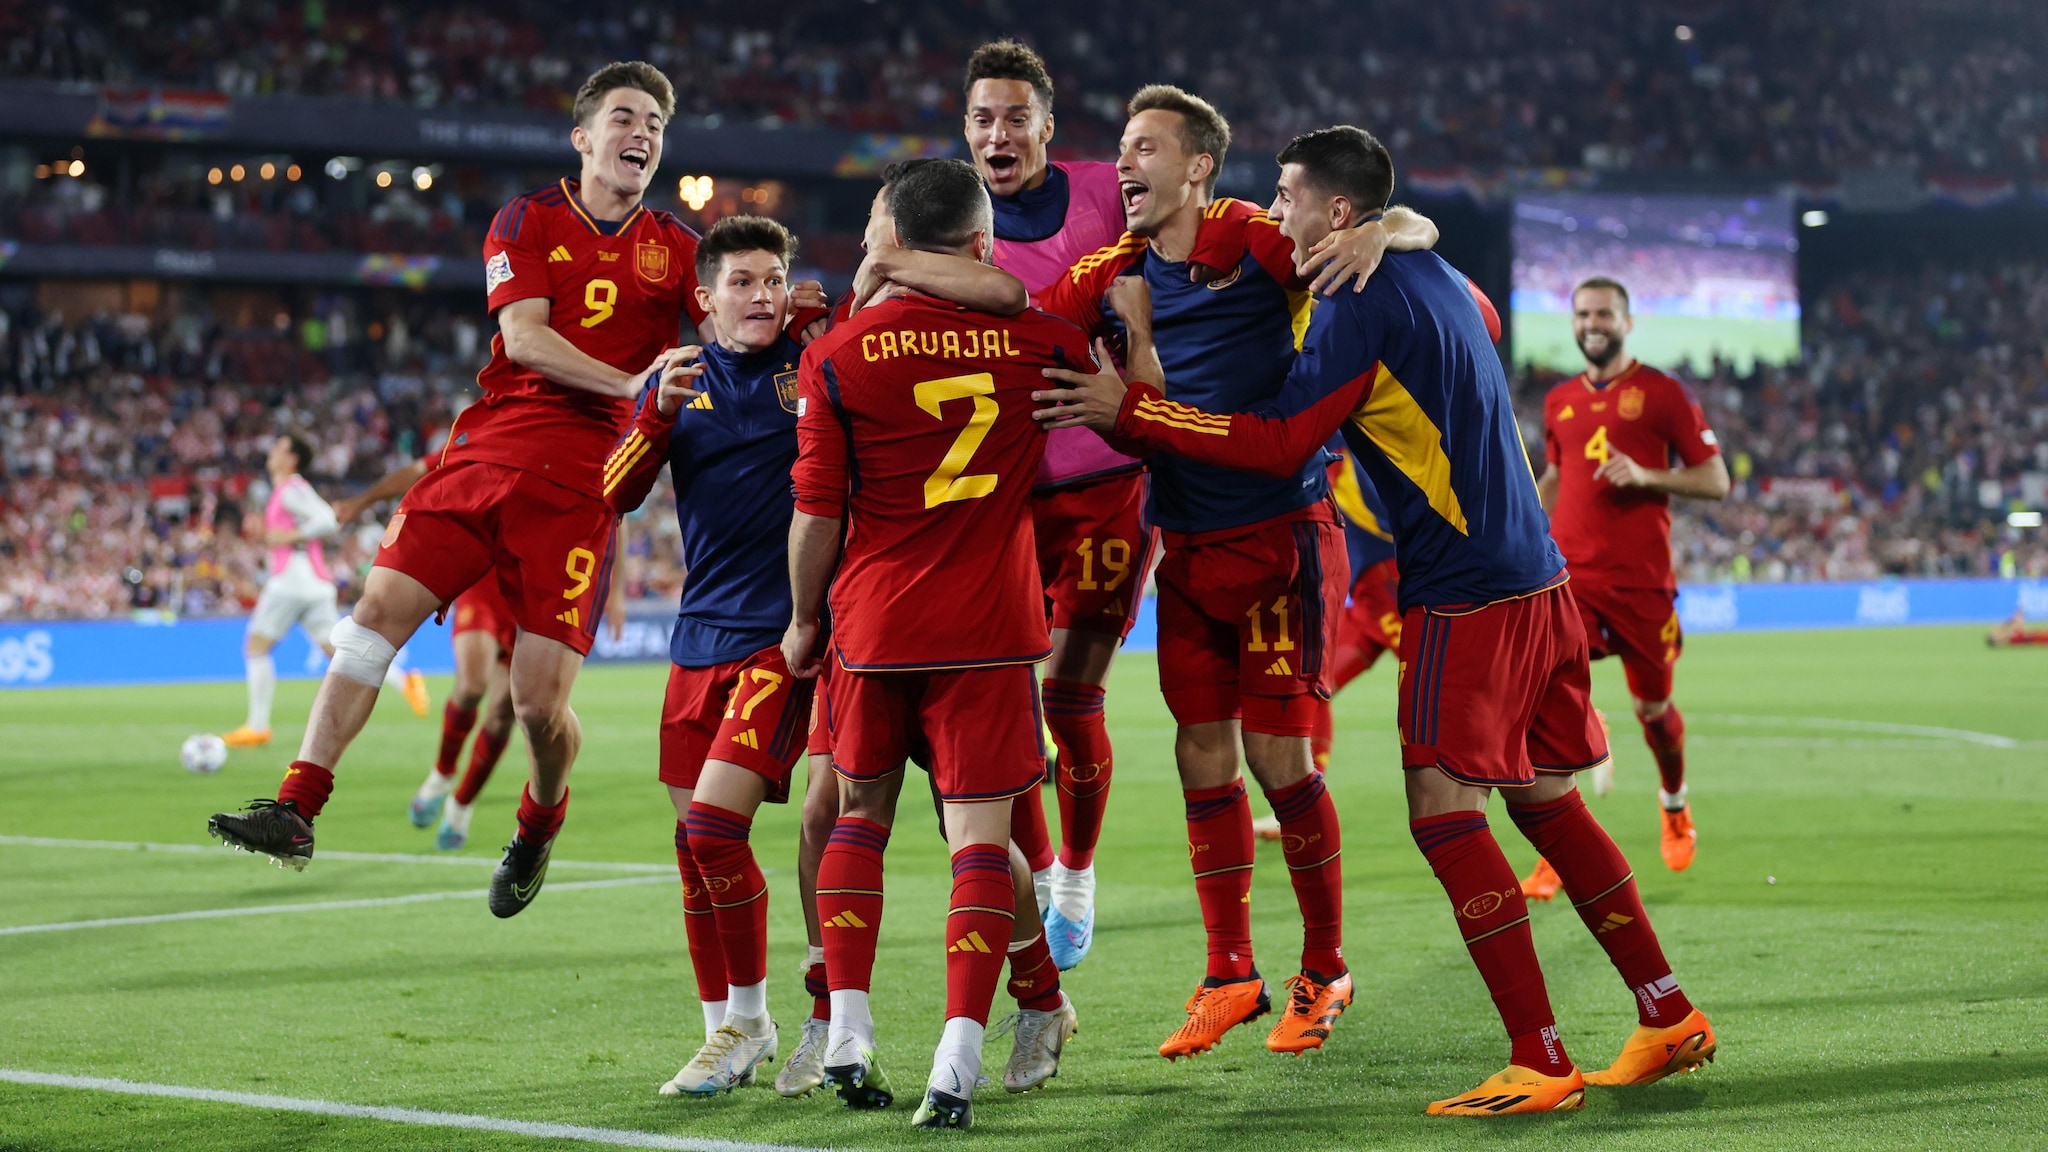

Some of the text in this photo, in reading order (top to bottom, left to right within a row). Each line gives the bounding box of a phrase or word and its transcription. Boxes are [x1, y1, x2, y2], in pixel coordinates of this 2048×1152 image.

[580, 278, 618, 329] 9
[861, 329, 1021, 362] CARVAJAL
[913, 372, 1000, 510] 2
[1584, 425, 1609, 465] 4
[563, 546, 596, 601] 9
[1075, 537, 1131, 591] 19
[1245, 595, 1295, 652] 11
[723, 668, 784, 721] 17
[1540, 1026, 1560, 1064] DESIGN
